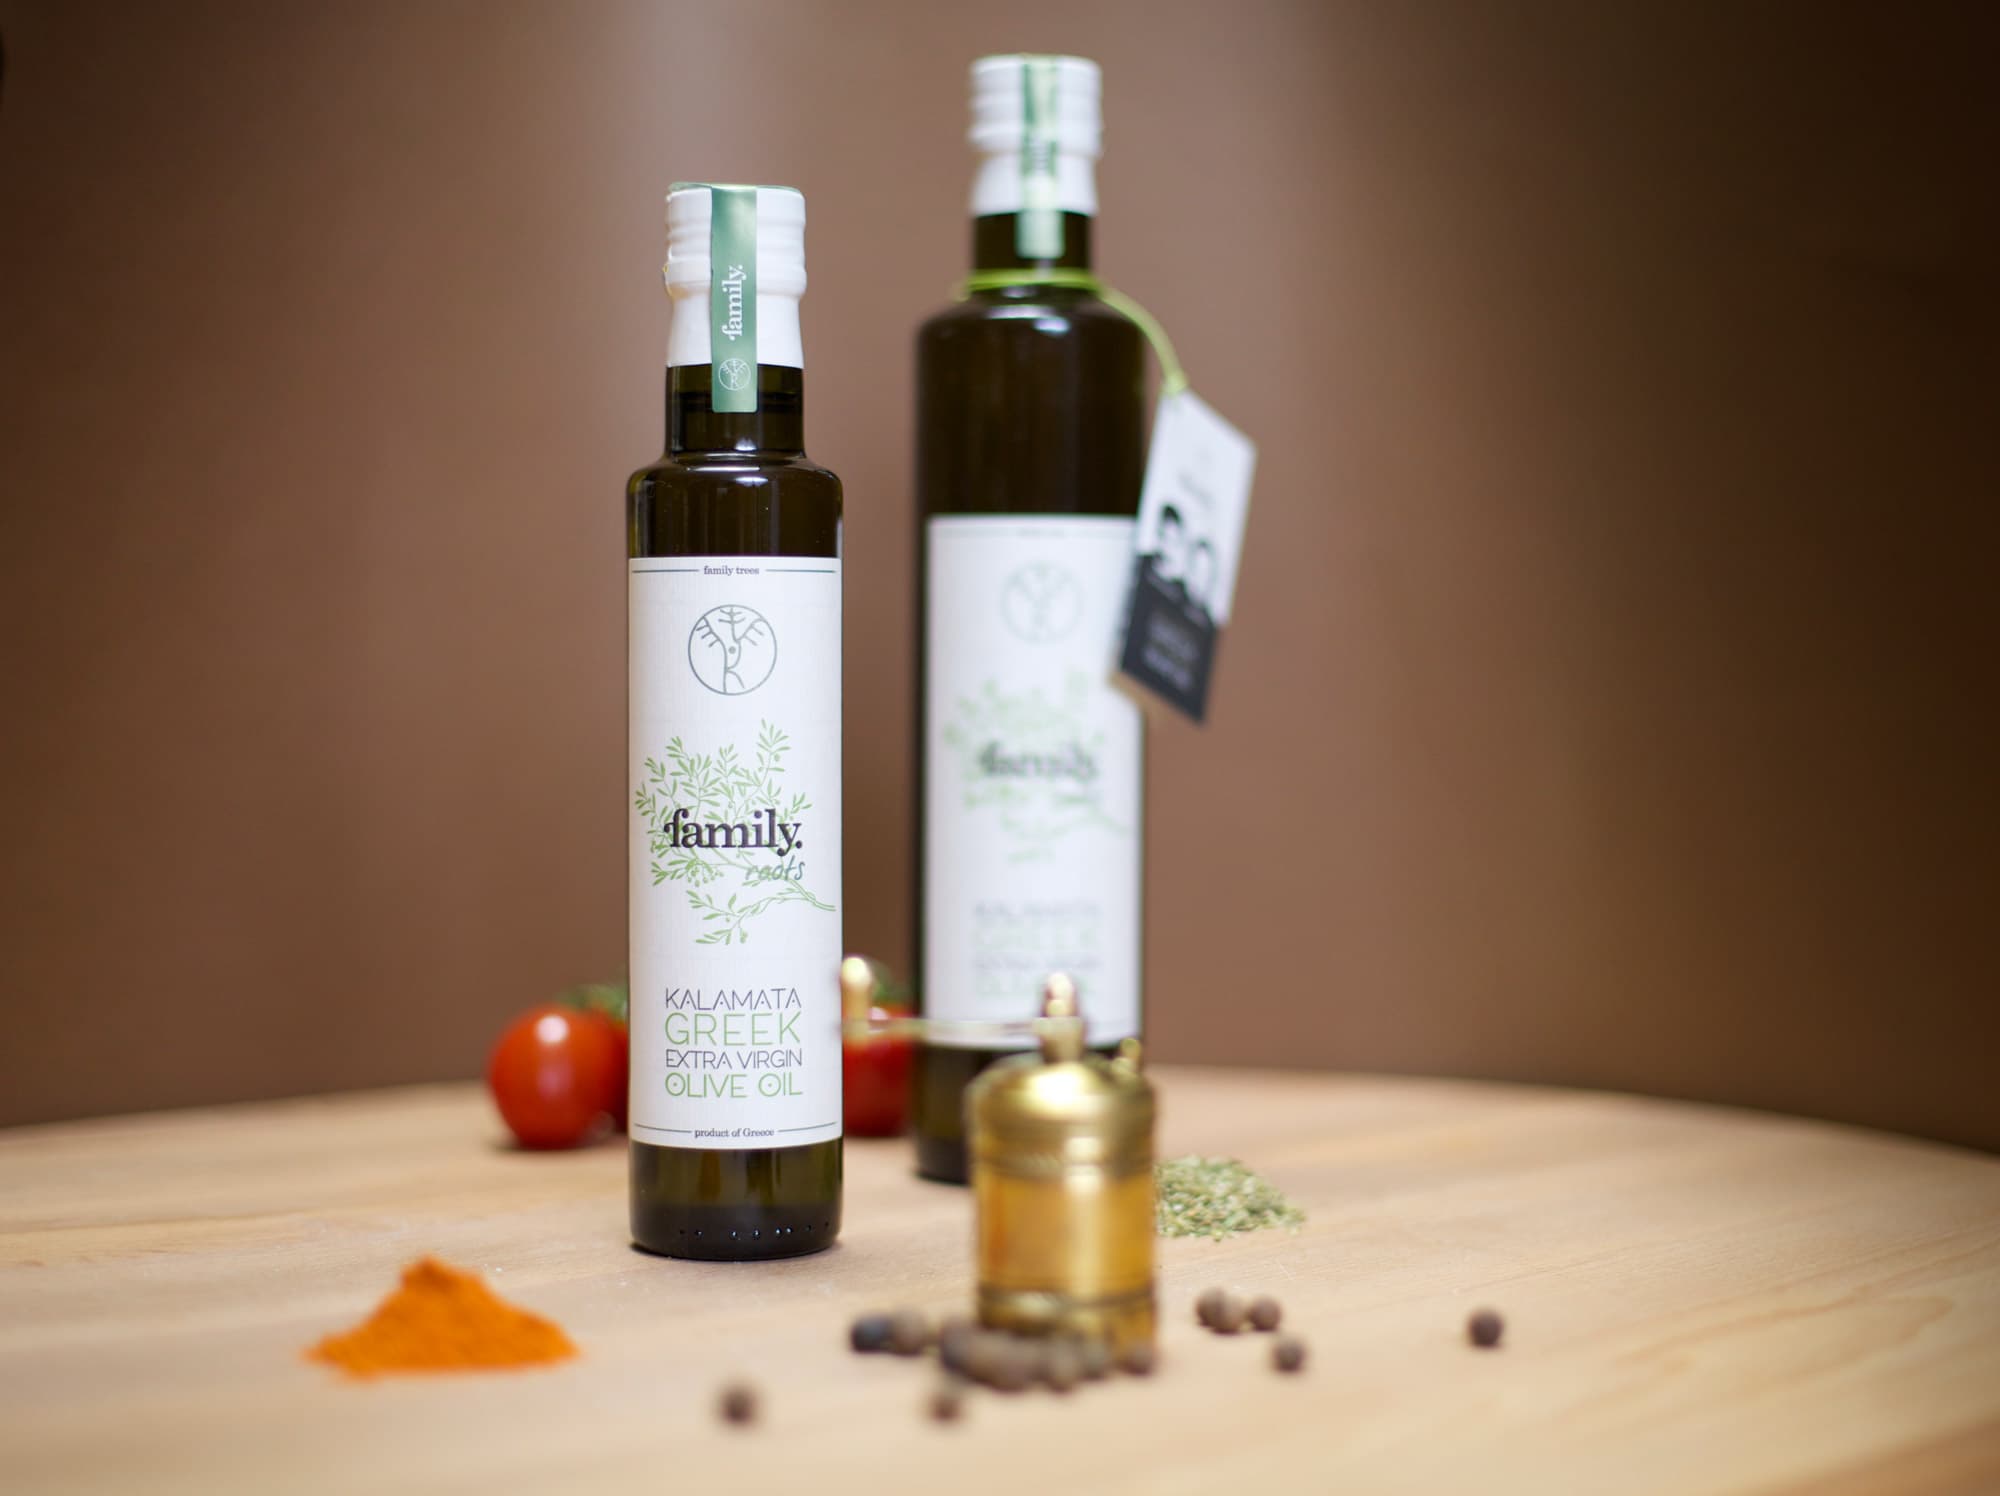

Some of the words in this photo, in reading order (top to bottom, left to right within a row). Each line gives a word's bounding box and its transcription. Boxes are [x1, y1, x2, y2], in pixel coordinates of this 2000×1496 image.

[703, 565, 733, 575] family
[735, 566, 760, 575] trees
[663, 808, 803, 857] family.
[745, 855, 806, 880] roots
[665, 987, 802, 1010] KALAMATA
[665, 1012, 802, 1046] GREEK
[665, 1049, 732, 1069] EXTRA
[737, 1048, 802, 1069] VIRGIN
[665, 1072, 748, 1098] OLIVE
[758, 1072, 803, 1097] OIL
[694, 1128, 730, 1138] product
[731, 1127, 742, 1138] of
[743, 1127, 775, 1138] Greece
